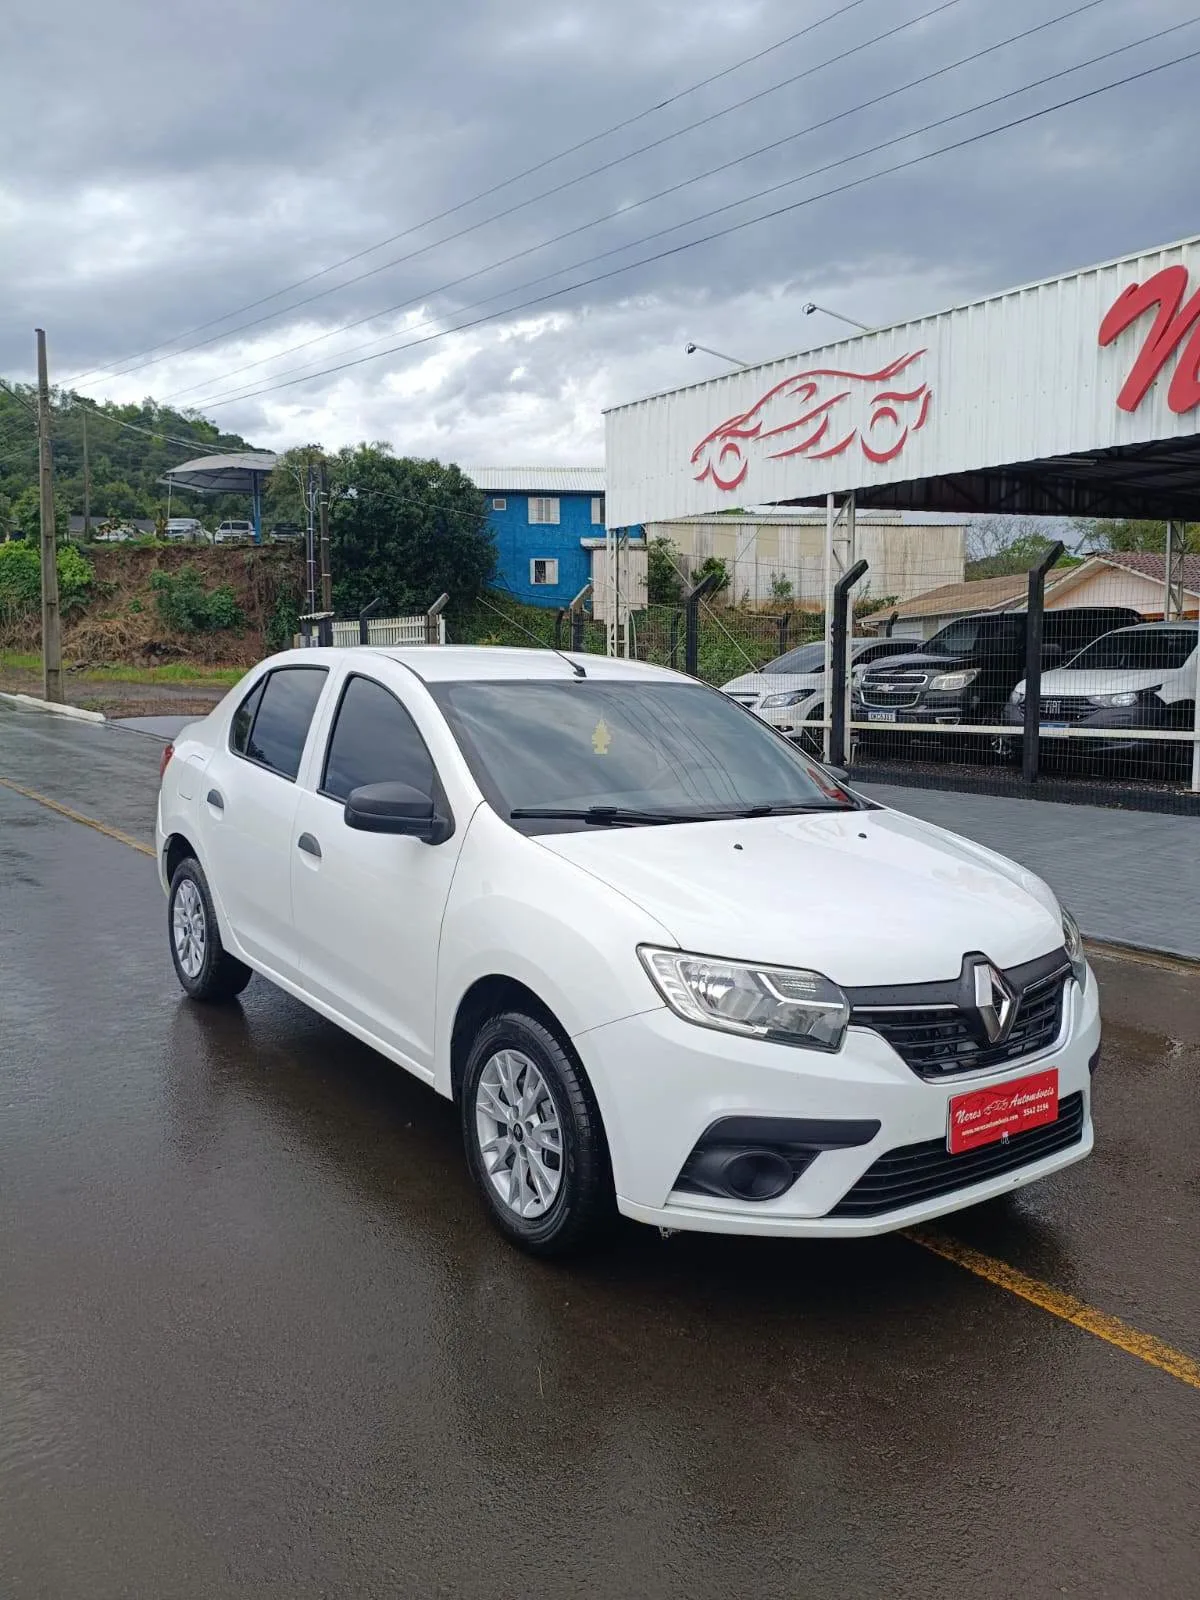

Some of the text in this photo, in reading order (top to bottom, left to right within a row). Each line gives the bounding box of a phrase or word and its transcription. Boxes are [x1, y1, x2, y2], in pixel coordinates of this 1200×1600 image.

[1045, 700, 1062, 715] FIAT
[955, 1087, 1055, 1123] Neres Automóveis
